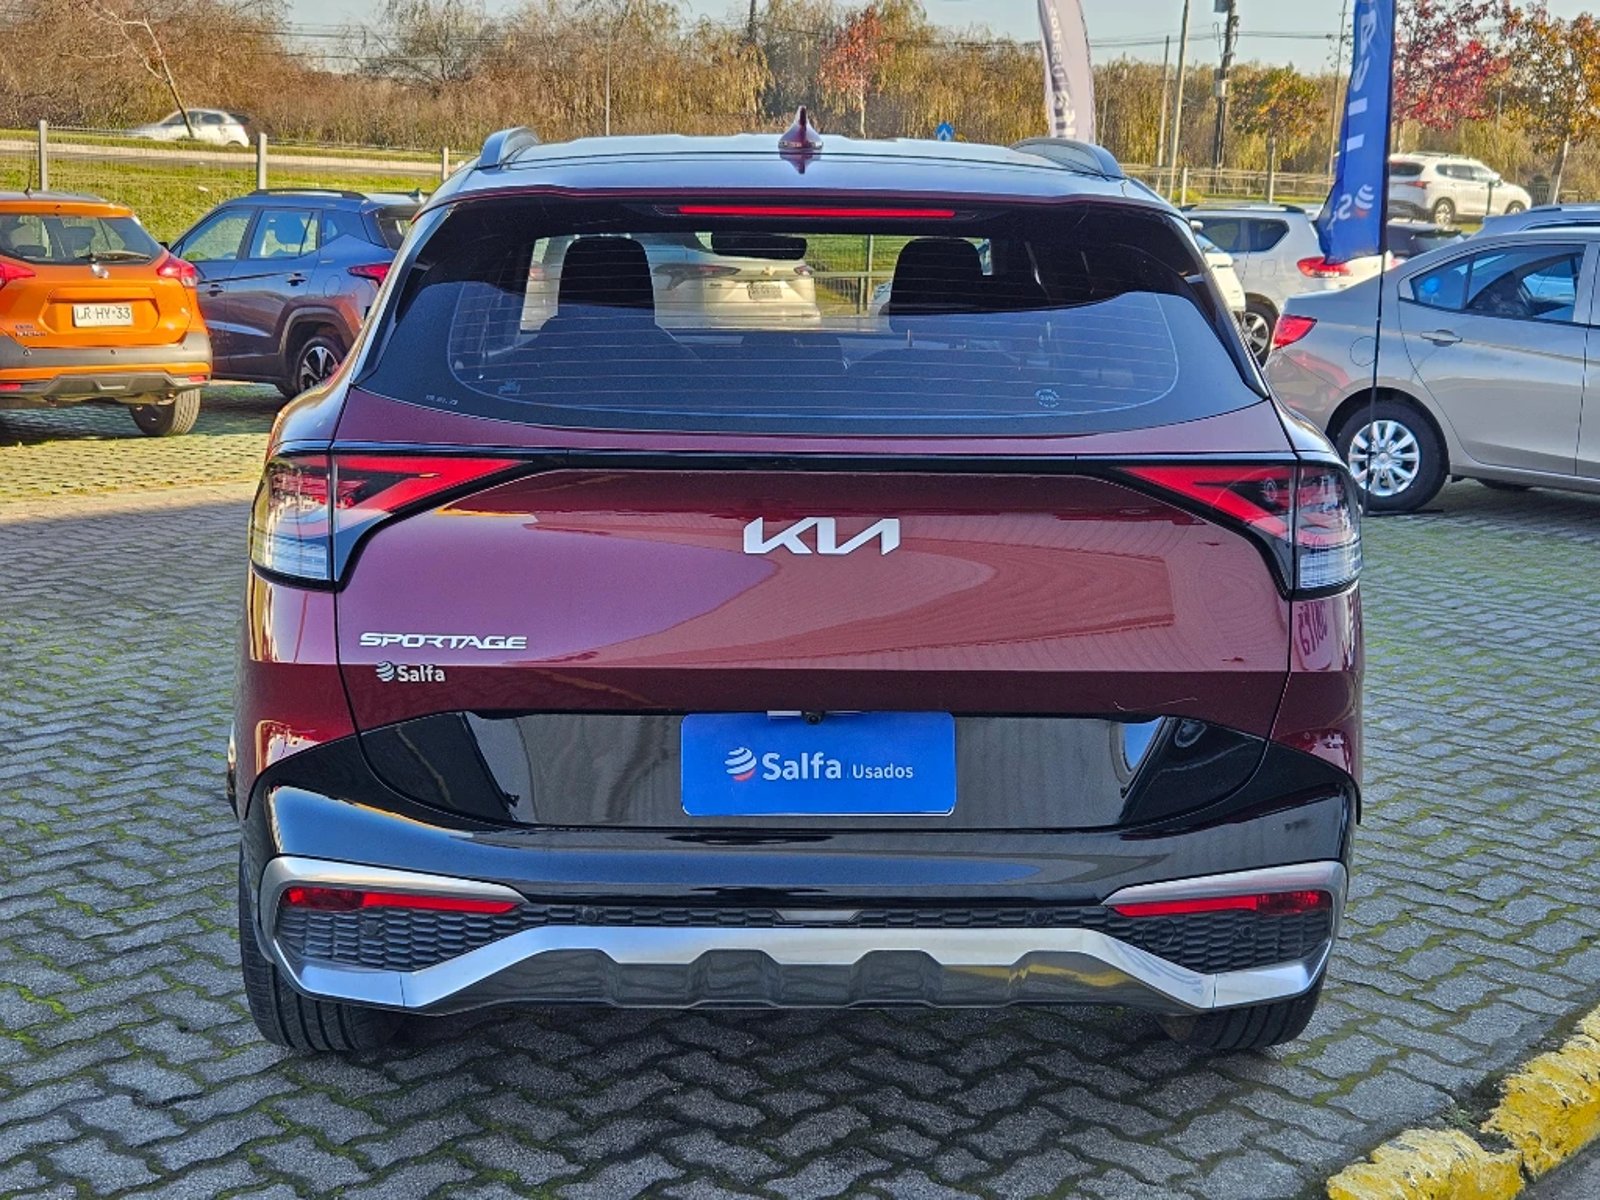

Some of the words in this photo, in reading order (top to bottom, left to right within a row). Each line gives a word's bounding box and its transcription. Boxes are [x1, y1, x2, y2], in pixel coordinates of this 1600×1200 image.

[743, 516, 900, 555] KIA
[359, 632, 528, 650] SPORTAGE
[396, 665, 446, 683] Salfa
[762, 752, 842, 781] Salfa
[851, 763, 914, 780] Usados
